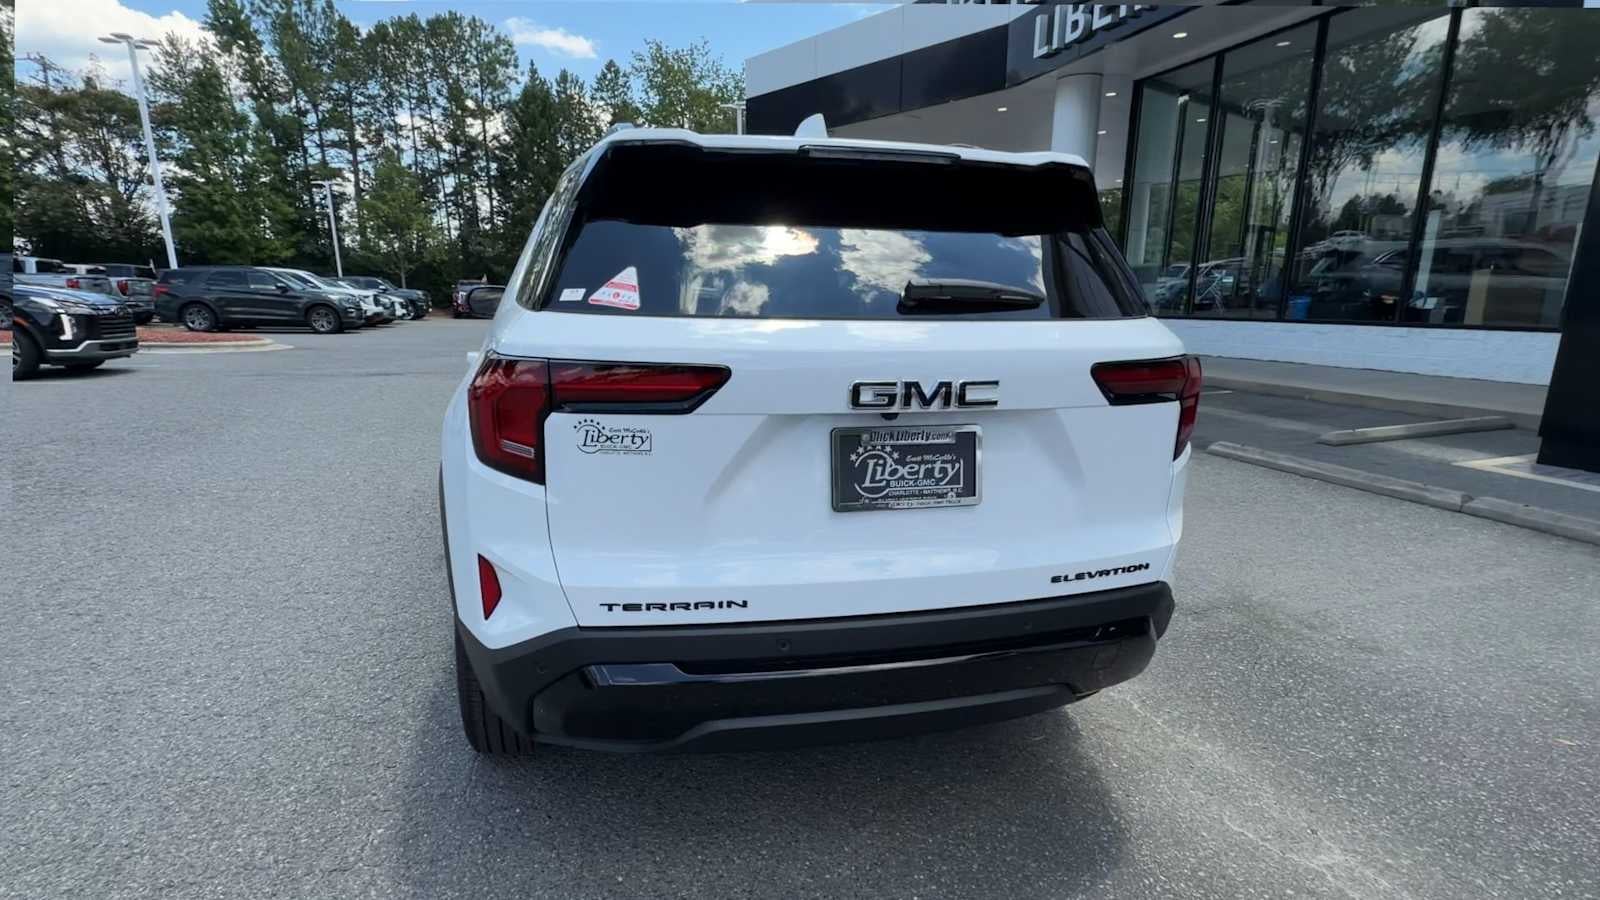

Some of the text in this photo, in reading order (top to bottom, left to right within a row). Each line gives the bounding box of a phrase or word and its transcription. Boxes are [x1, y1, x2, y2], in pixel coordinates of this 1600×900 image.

[1033, 5, 1143, 58] LIBE
[848, 380, 1000, 410] GMC
[582, 429, 649, 450] Liberty
[862, 457, 960, 487] Liberty
[1050, 562, 1150, 583] ELEVATION
[599, 600, 748, 612] TERRAIN
